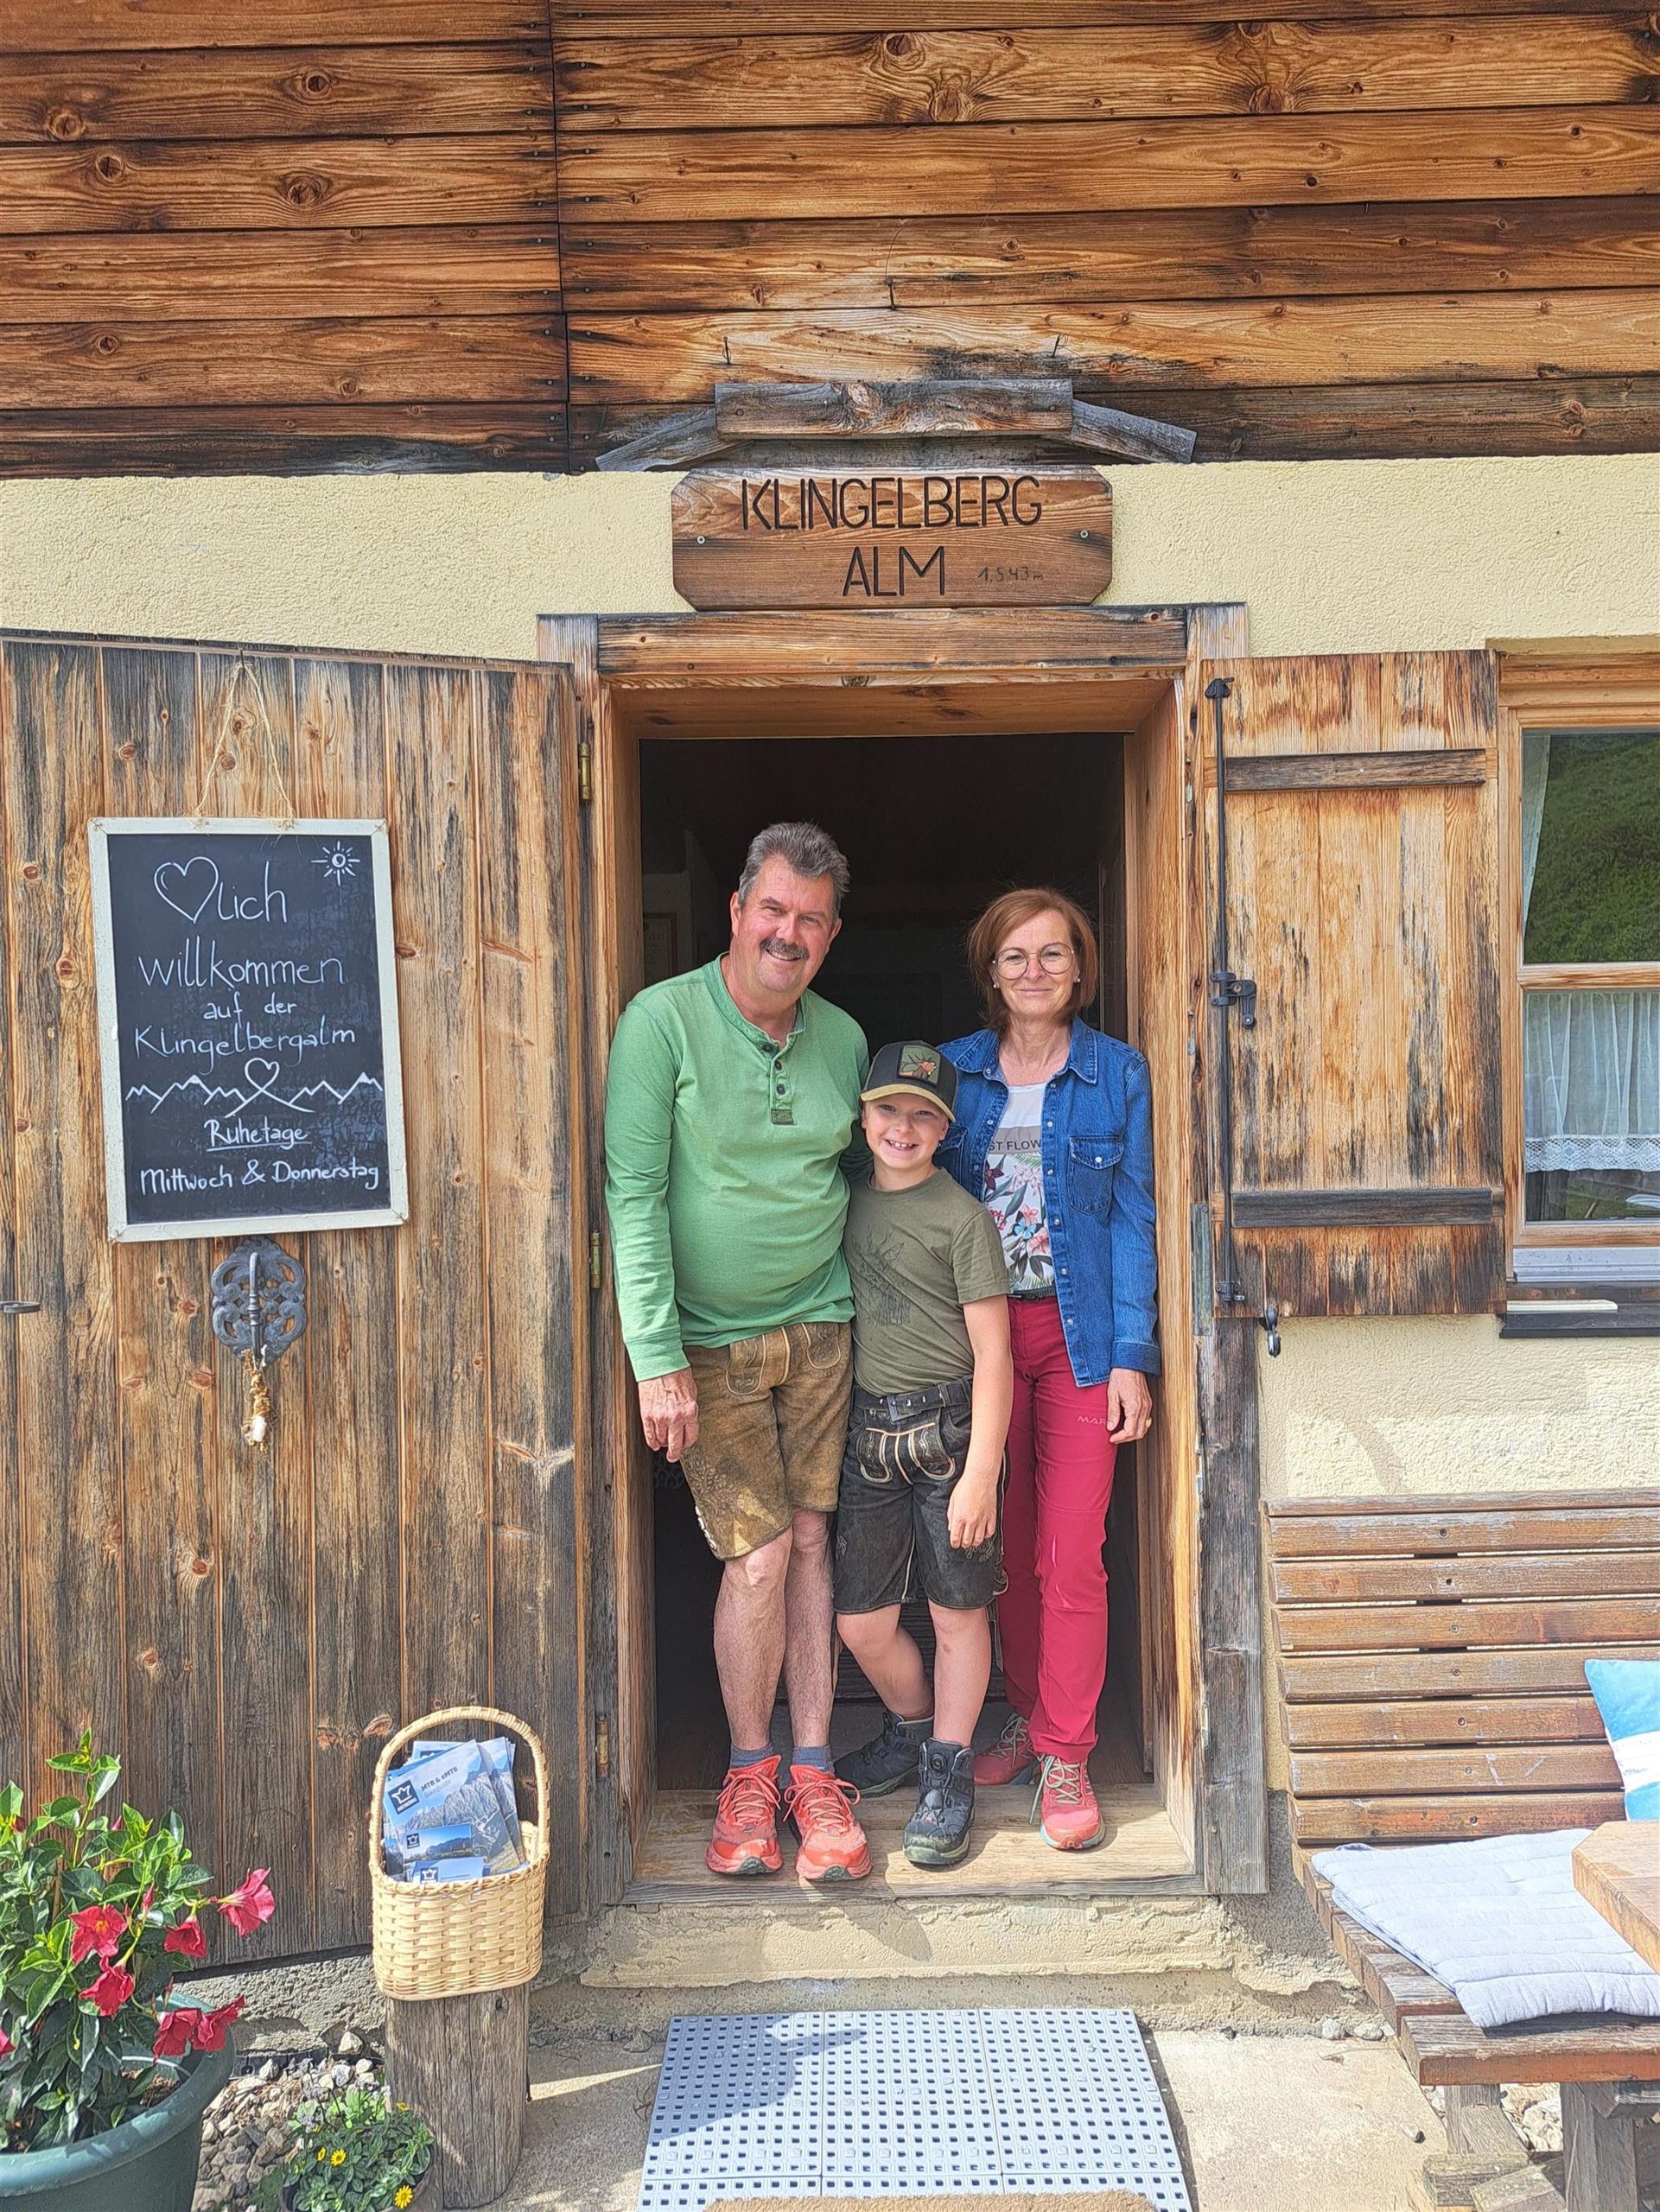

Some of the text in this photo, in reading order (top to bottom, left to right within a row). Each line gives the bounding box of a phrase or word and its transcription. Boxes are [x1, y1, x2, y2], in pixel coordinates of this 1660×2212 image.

[741, 475, 1043, 530] KLINGELBERG
[842, 545, 946, 597] ALM
[202, 991, 297, 1028] auf der
[134, 1014, 356, 1076] Klingelbergalm
[203, 1116, 308, 1150] Ruhetage
[140, 1156, 379, 1195] Mittwoch & Donnerstag
[421, 1780, 436, 1792] MTB
